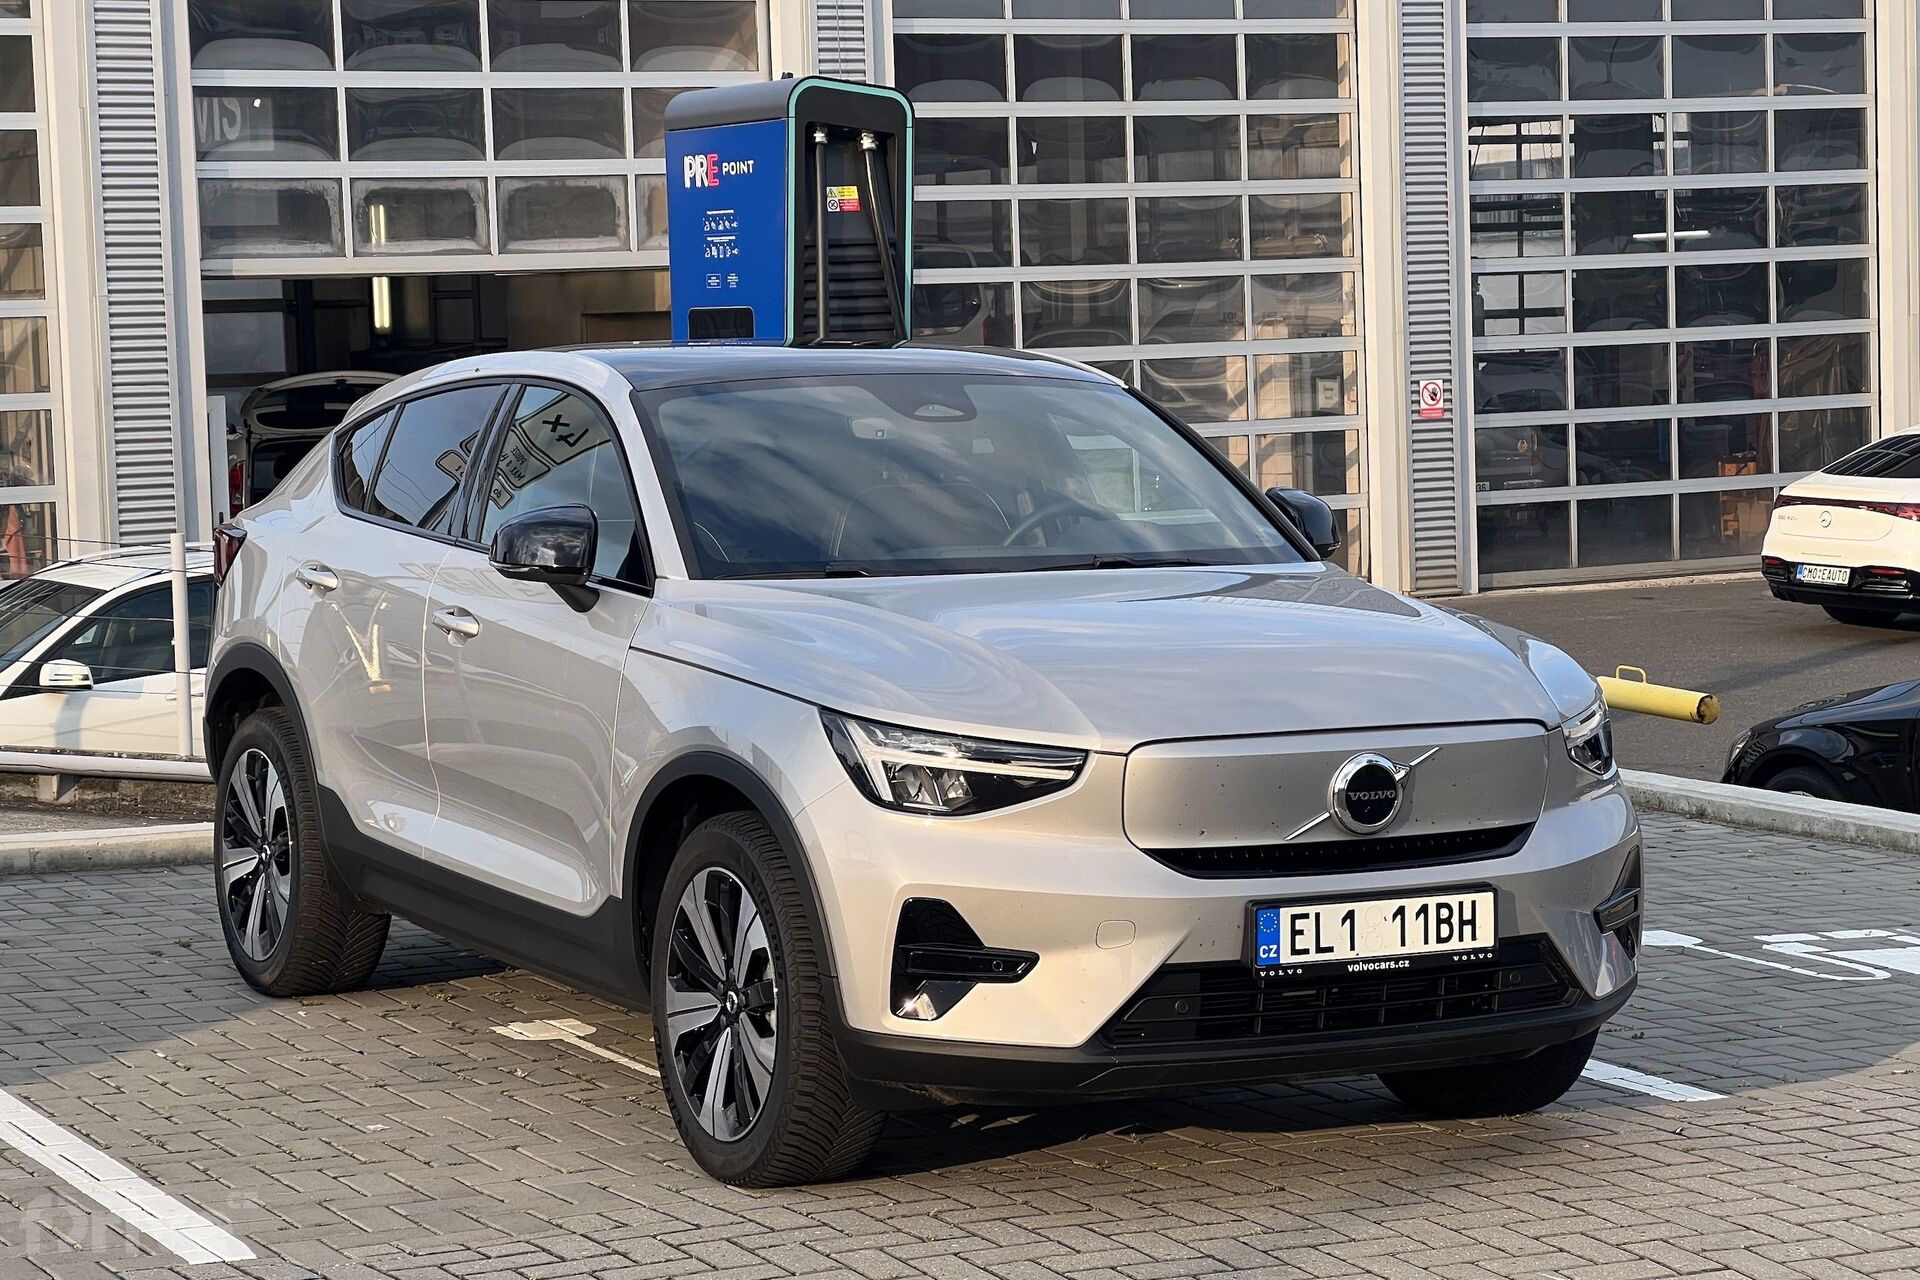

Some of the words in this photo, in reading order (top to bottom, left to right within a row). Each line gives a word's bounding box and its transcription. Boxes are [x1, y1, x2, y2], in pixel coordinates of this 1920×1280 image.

[683, 154, 720, 188] PRE
[722, 160, 755, 176] POINT
[1347, 789, 1396, 801] VOLVO
[1290, 909, 1355, 956] EL1
[1392, 900, 1478, 947] 11BH
[1259, 944, 1278, 958] CZ
[1260, 968, 1303, 977] VOLVO
[1347, 959, 1410, 972] volvocars.cz
[1453, 952, 1493, 961] VOLVO
